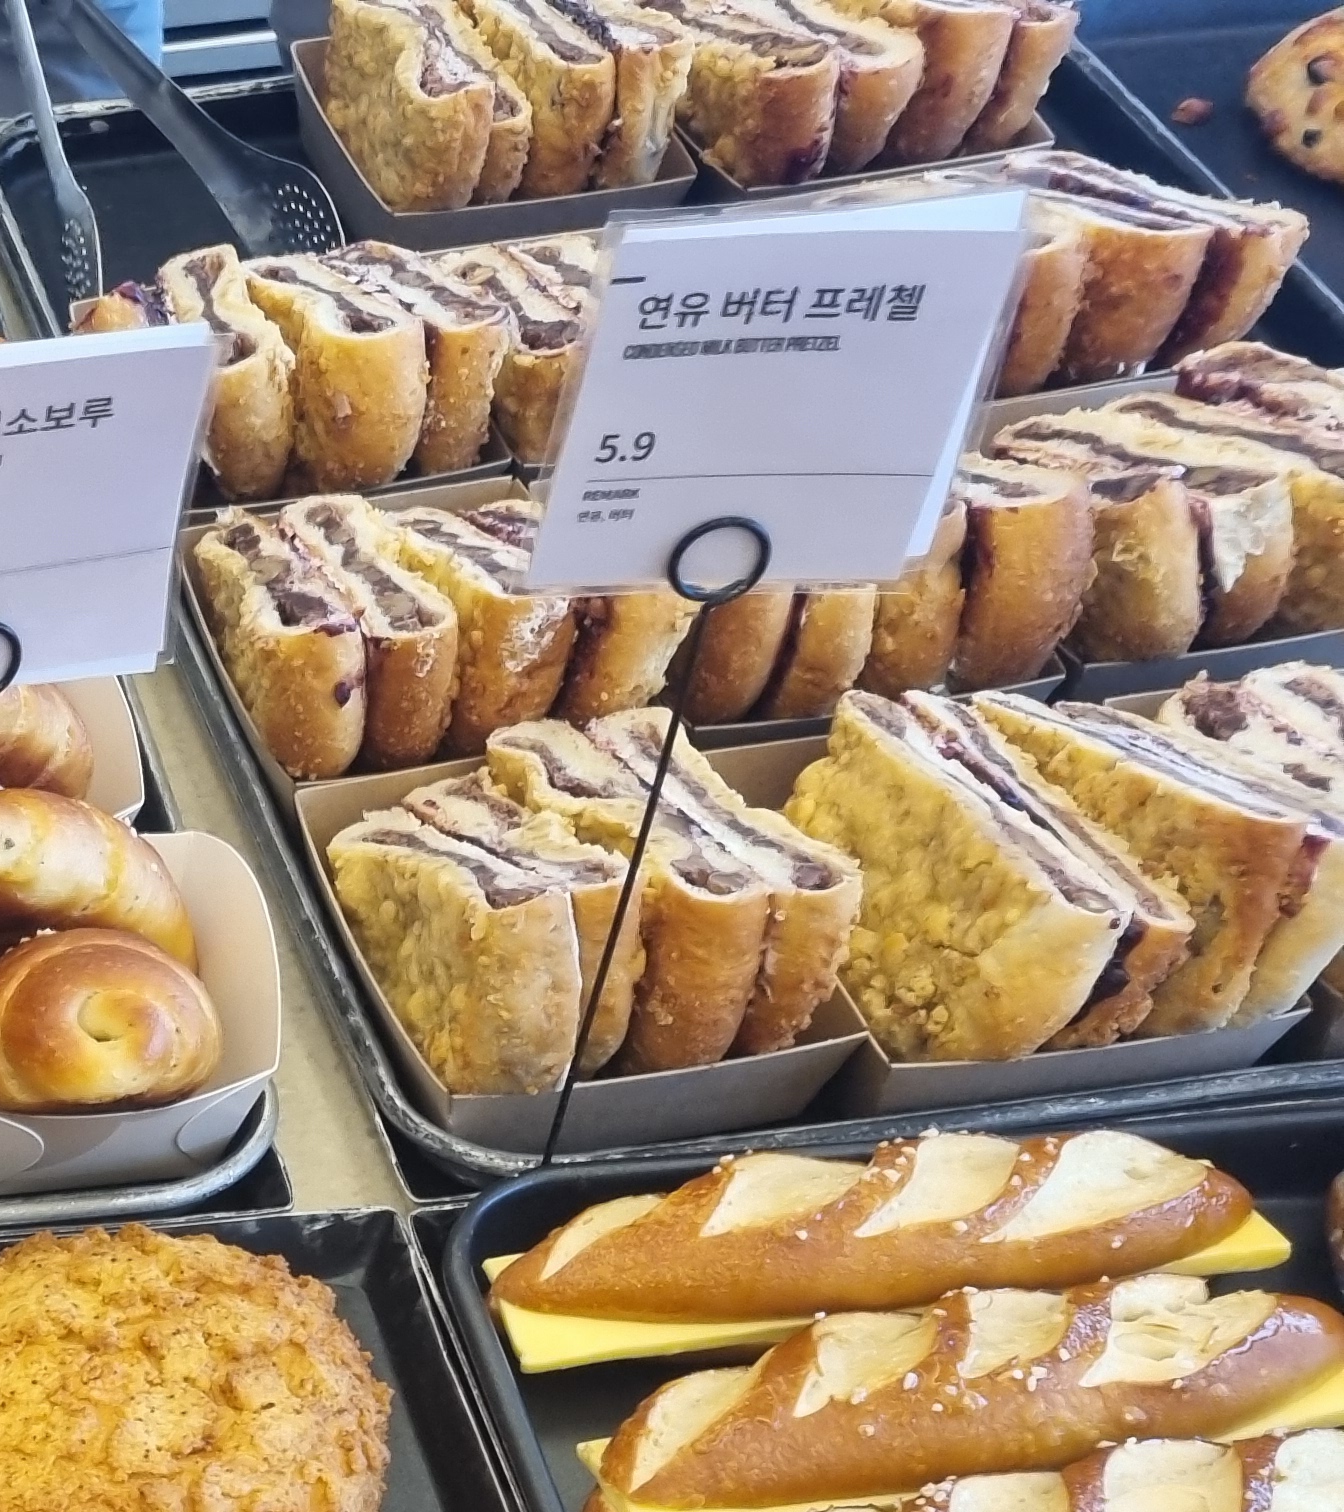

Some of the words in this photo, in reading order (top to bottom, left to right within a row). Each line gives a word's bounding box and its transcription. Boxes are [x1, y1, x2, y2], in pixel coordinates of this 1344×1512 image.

[637, 292, 711, 330] 연유
[719, 286, 801, 325] 버터
[804, 283, 926, 323] 프레첼
[594, 431, 656, 464] 5.9
